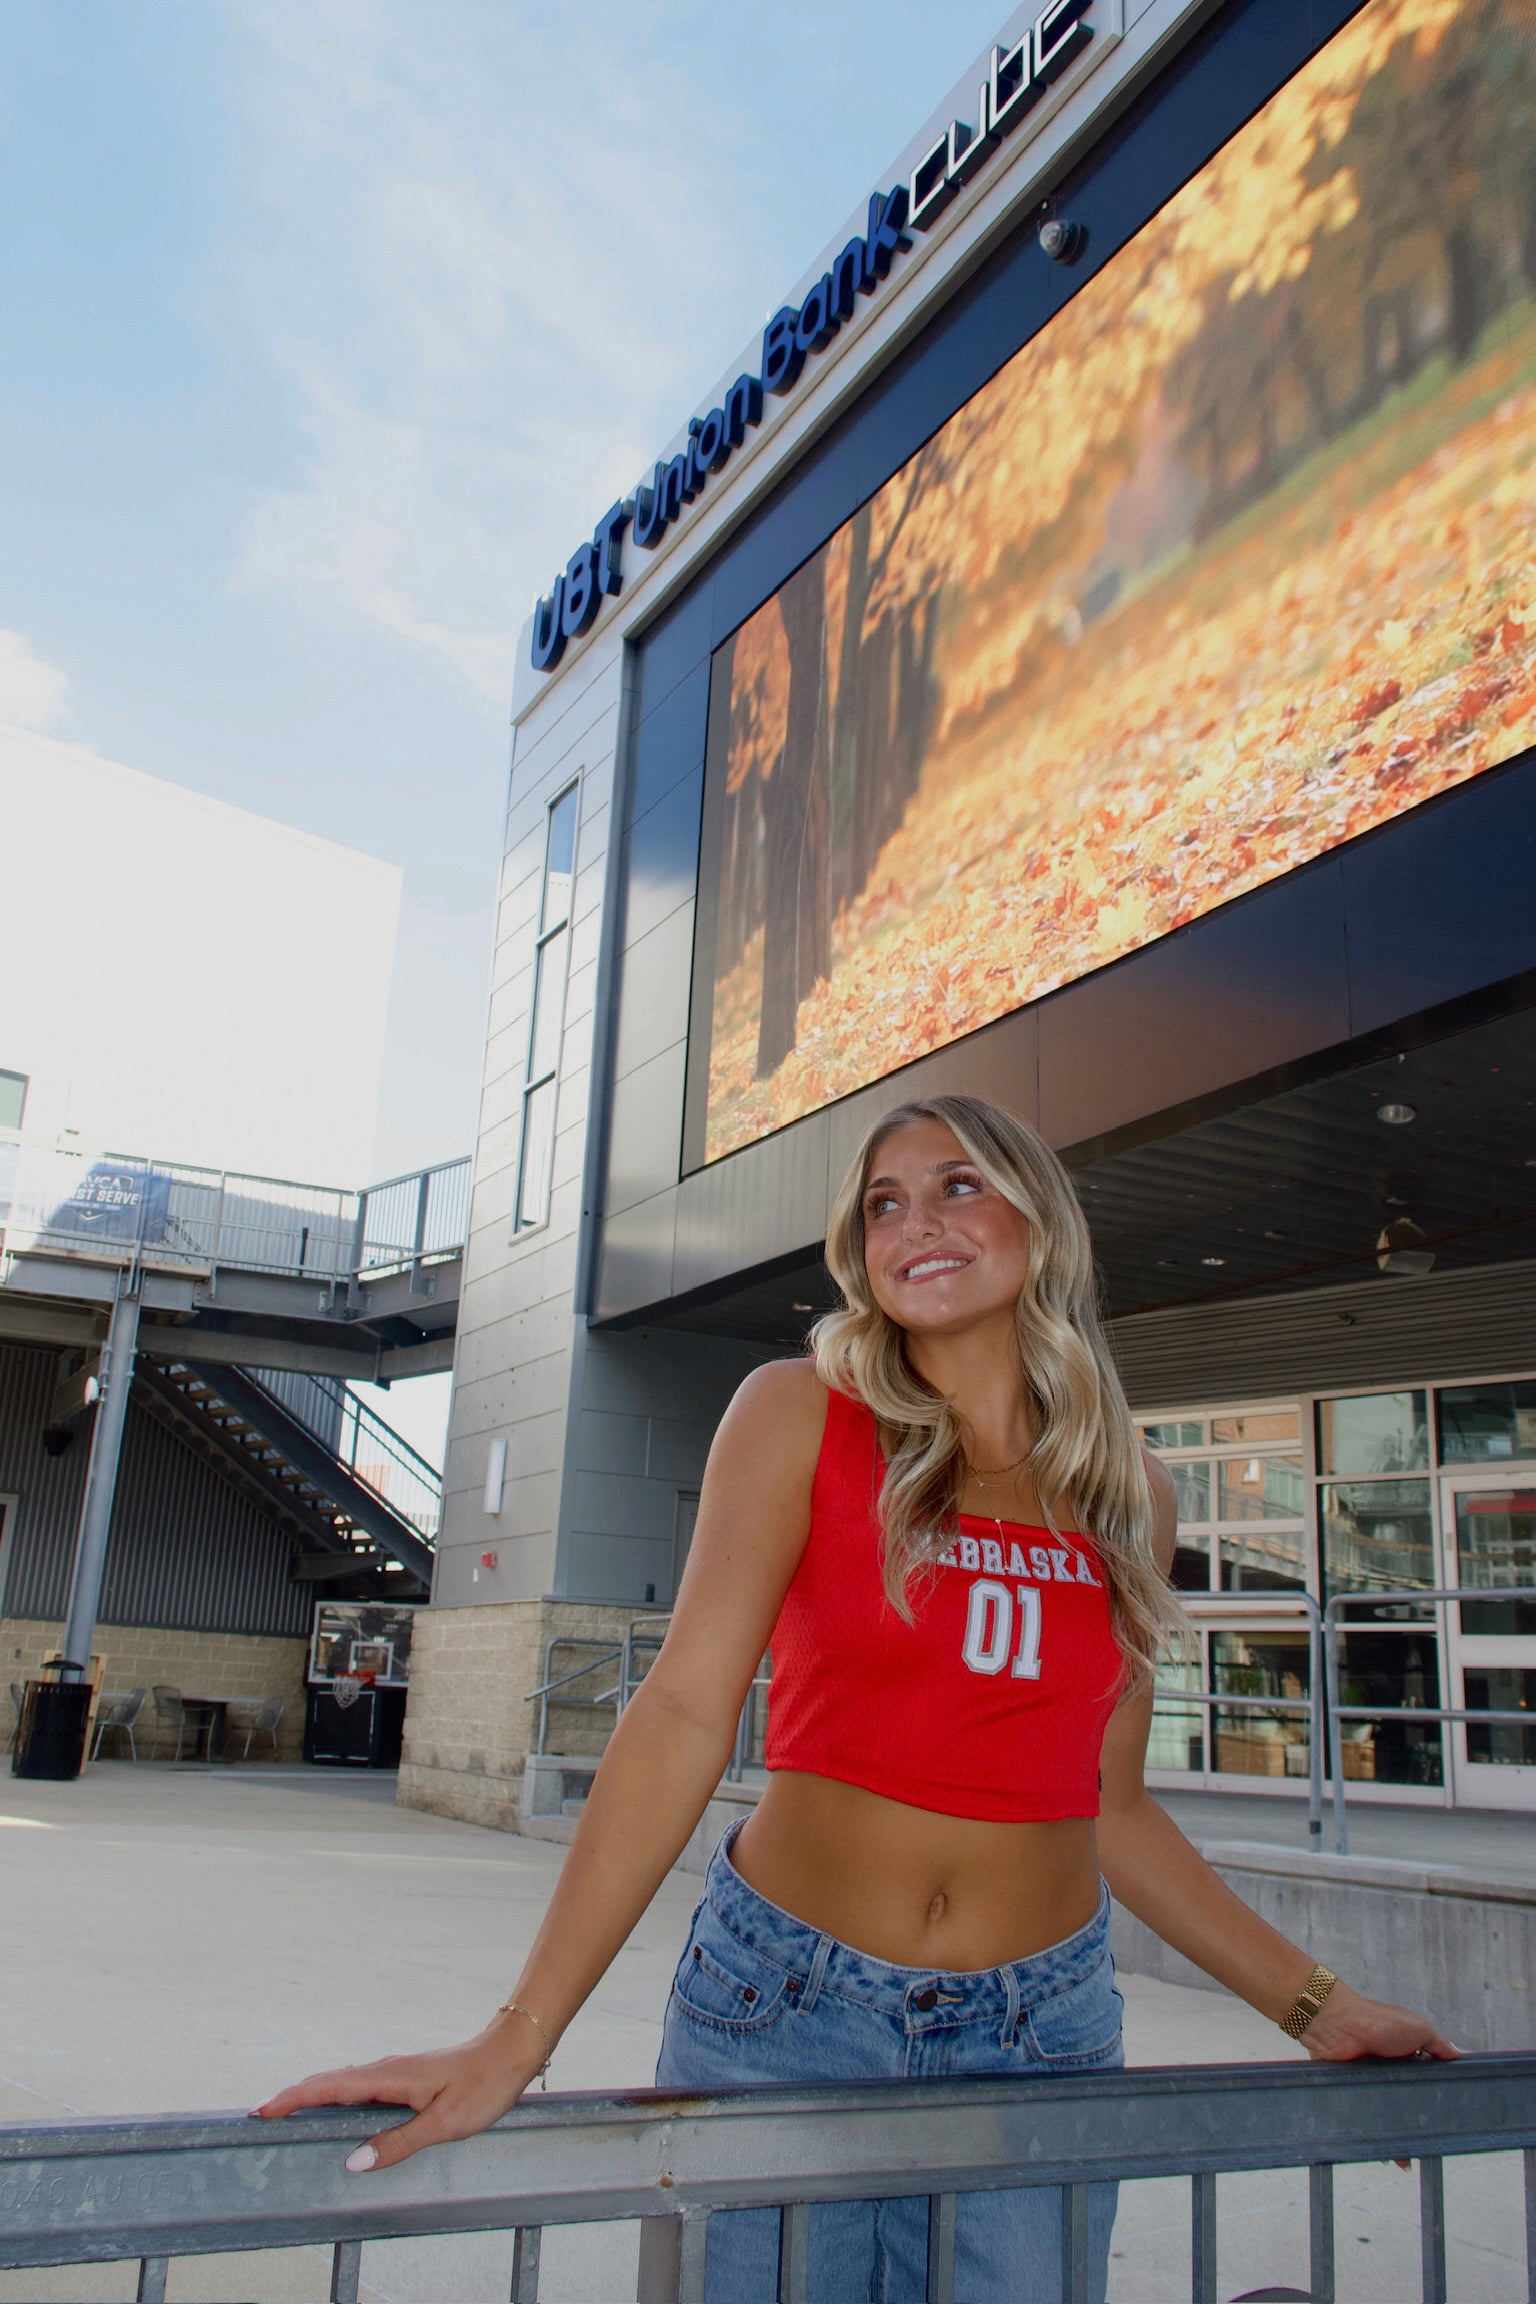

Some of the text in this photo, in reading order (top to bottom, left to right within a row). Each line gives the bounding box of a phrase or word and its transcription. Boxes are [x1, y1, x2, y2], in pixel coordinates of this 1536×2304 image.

[531, 0, 1086, 672] UBT Union Bank cube
[97, 1191, 139, 1205] SERVE
[961, 1577, 1042, 1680] 01
